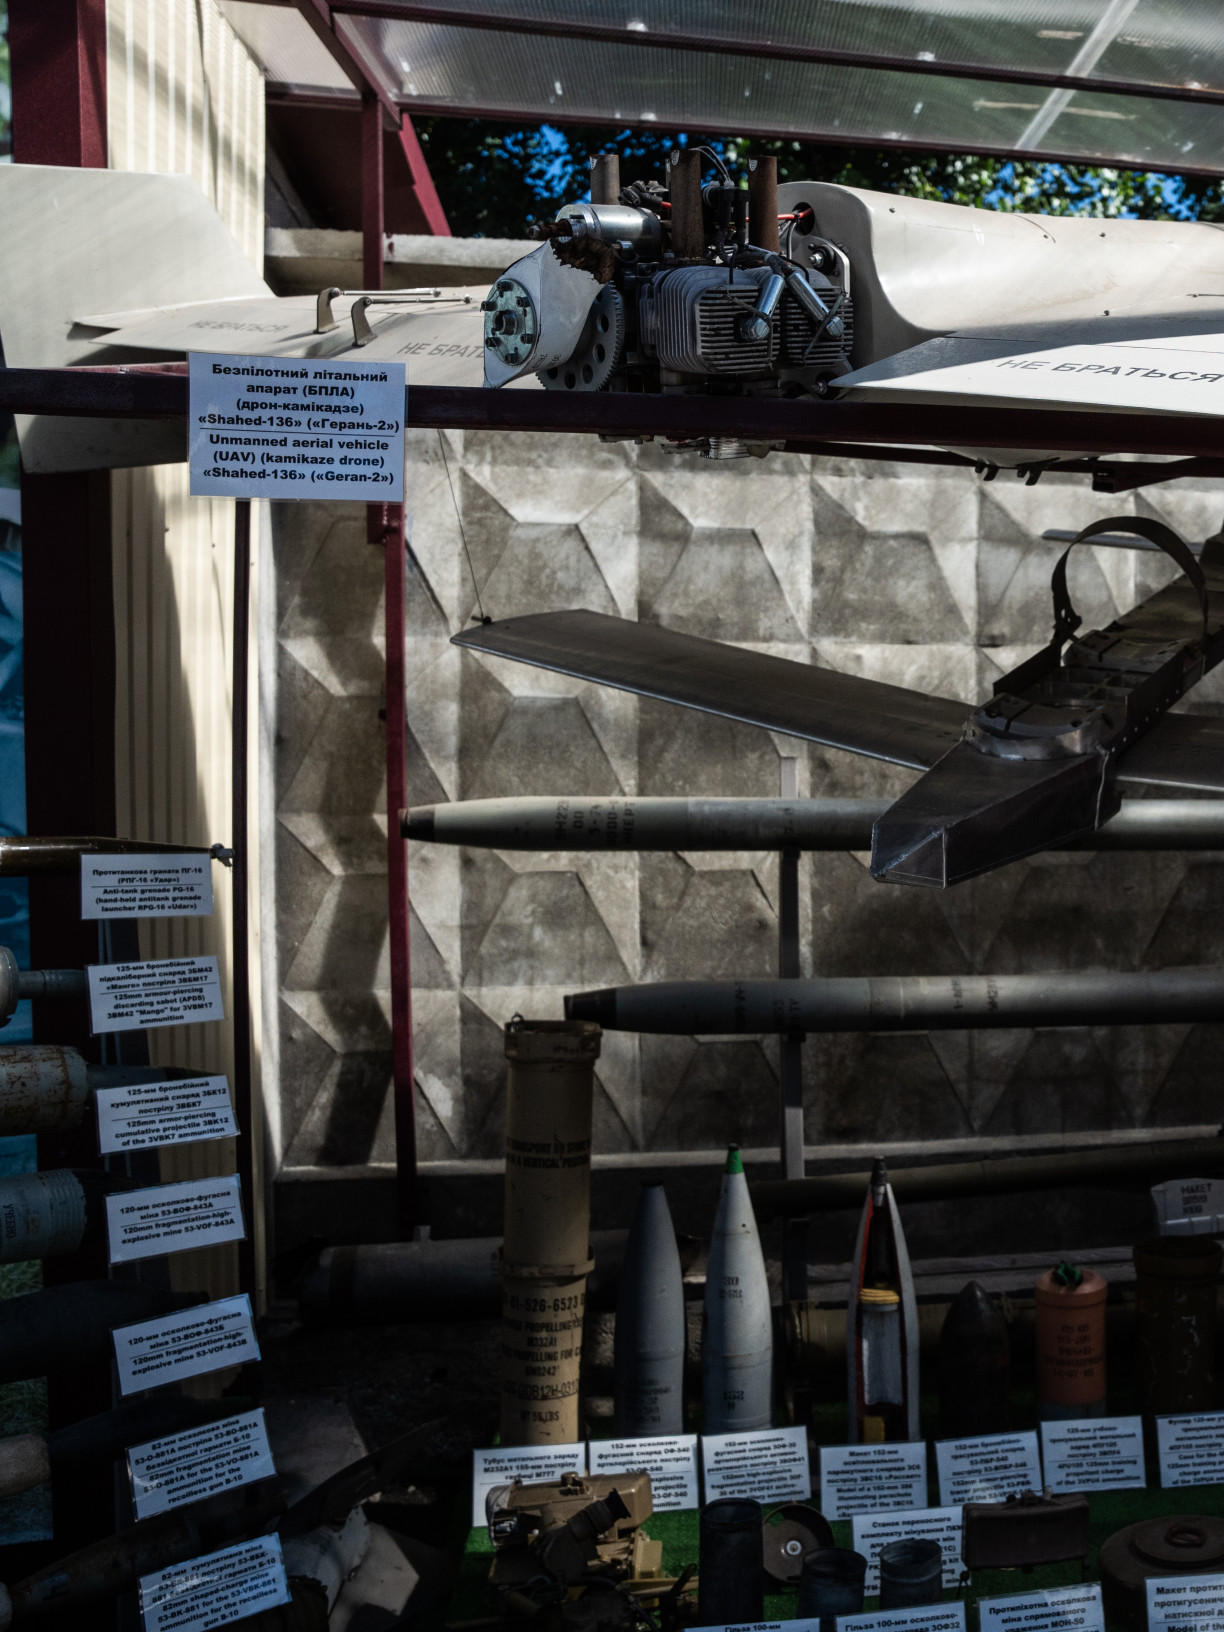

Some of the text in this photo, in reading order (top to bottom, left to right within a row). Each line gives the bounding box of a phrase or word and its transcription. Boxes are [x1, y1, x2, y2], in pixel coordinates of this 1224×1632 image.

[397, 342, 431, 355] НЕ
[212, 362, 387, 382] Безпілотний літальний
[997, 359, 1050, 370] НЕ
[245, 384, 354, 400] апарат (БПЛА)
[235, 397, 364, 416] (дрон-камікадзе)
[197, 413, 399, 433] «Shahed-136» («Герань-2»)
[209, 433, 389, 450] Unmanned aerial vehicle
[212, 450, 384, 469] (UAV) (kamikaze drone)
[202, 466, 394, 485] «Shahed-136» («Geran-2»)
